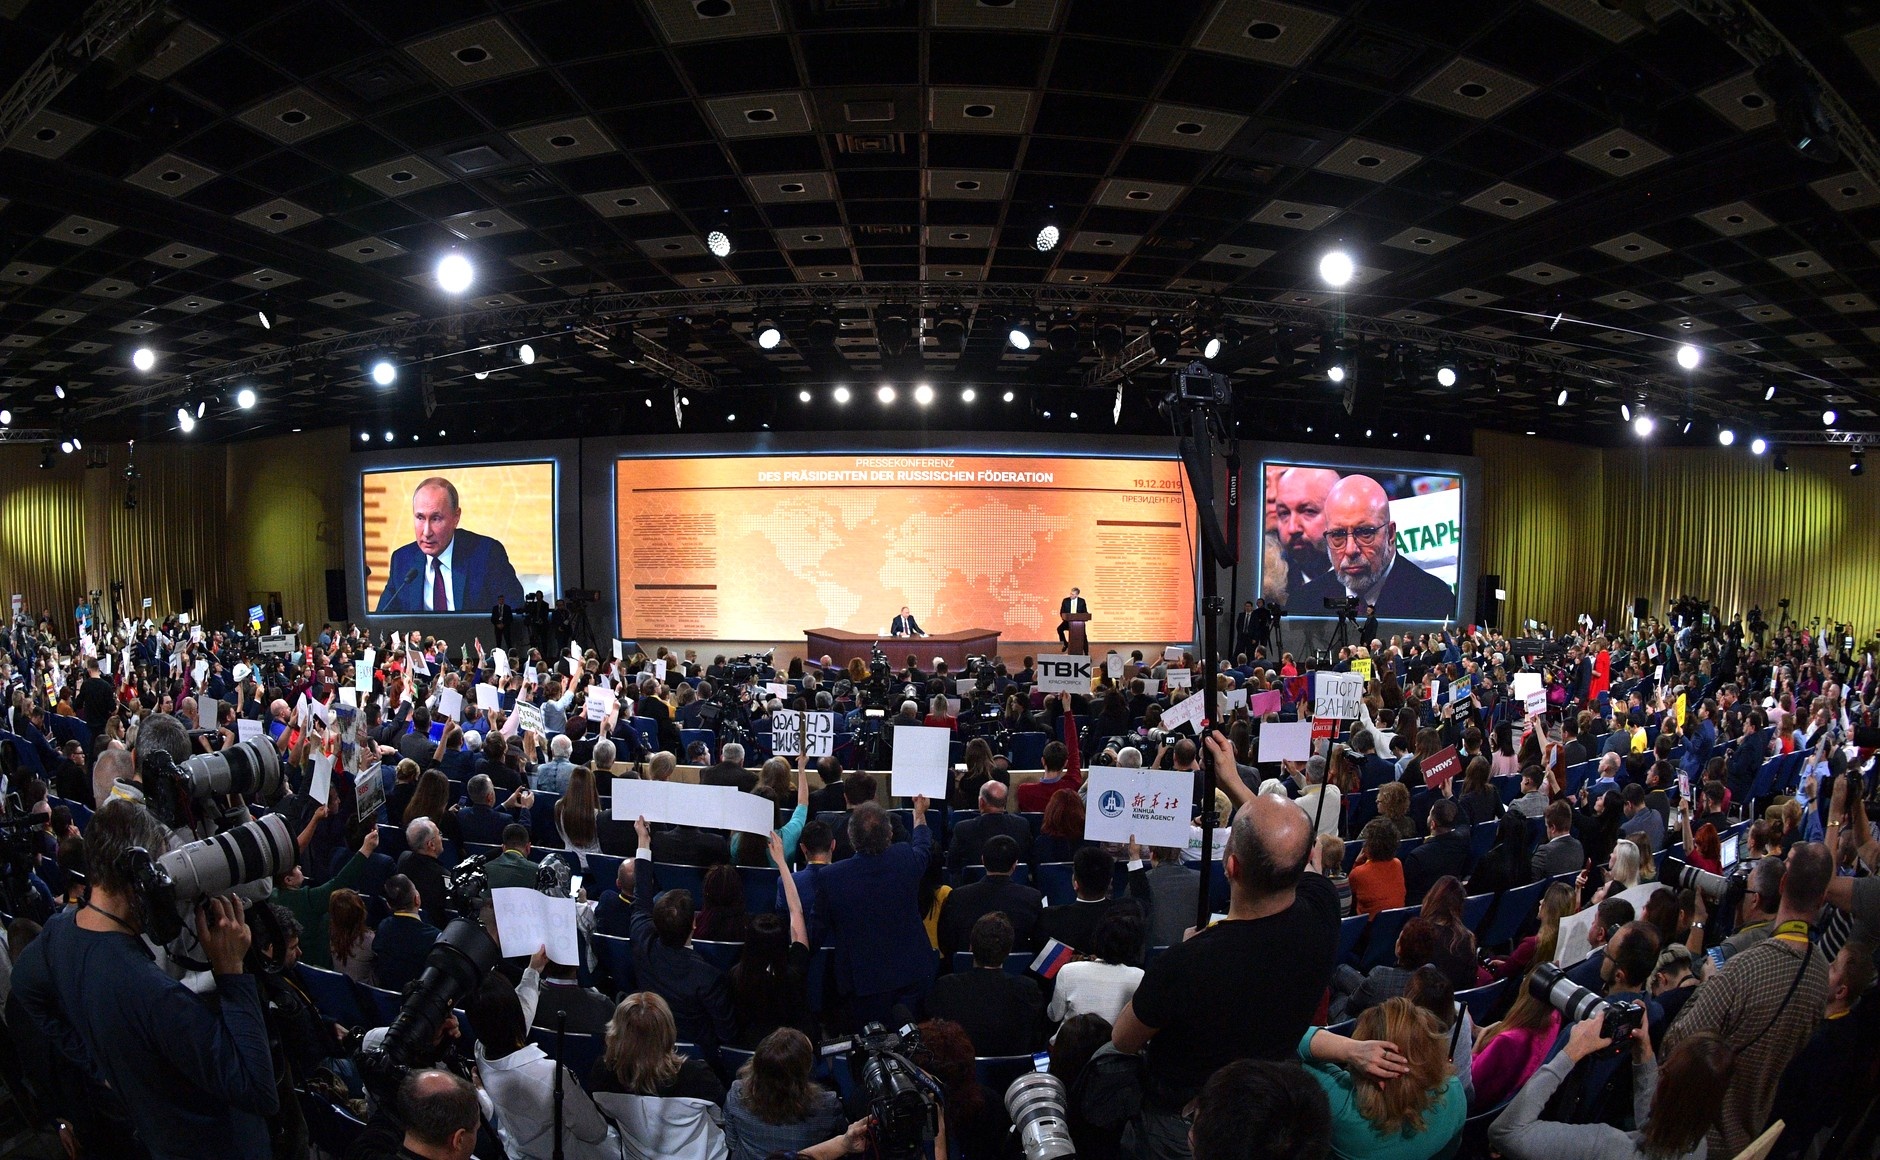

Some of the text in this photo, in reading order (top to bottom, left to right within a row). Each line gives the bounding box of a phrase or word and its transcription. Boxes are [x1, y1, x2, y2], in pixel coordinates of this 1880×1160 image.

[856, 458, 954, 468] PRESSEKONFERENZ
[758, 470, 1054, 482] DES PRÄSIDENTEN DER RUSSISCHEN FÖDERATION
[1133, 480, 1182, 489] 19.12.2019
[1122, 495, 1182, 504] ПРЕЗИДЕНТ.РФ
[1038, 661, 1091, 678] ТВК
[1326, 680, 1362, 698] ПОРТ
[1316, 698, 1360, 718] ВАНИНО
[1432, 758, 1453, 774] NEWS
[358, 784, 369, 796] SOS
